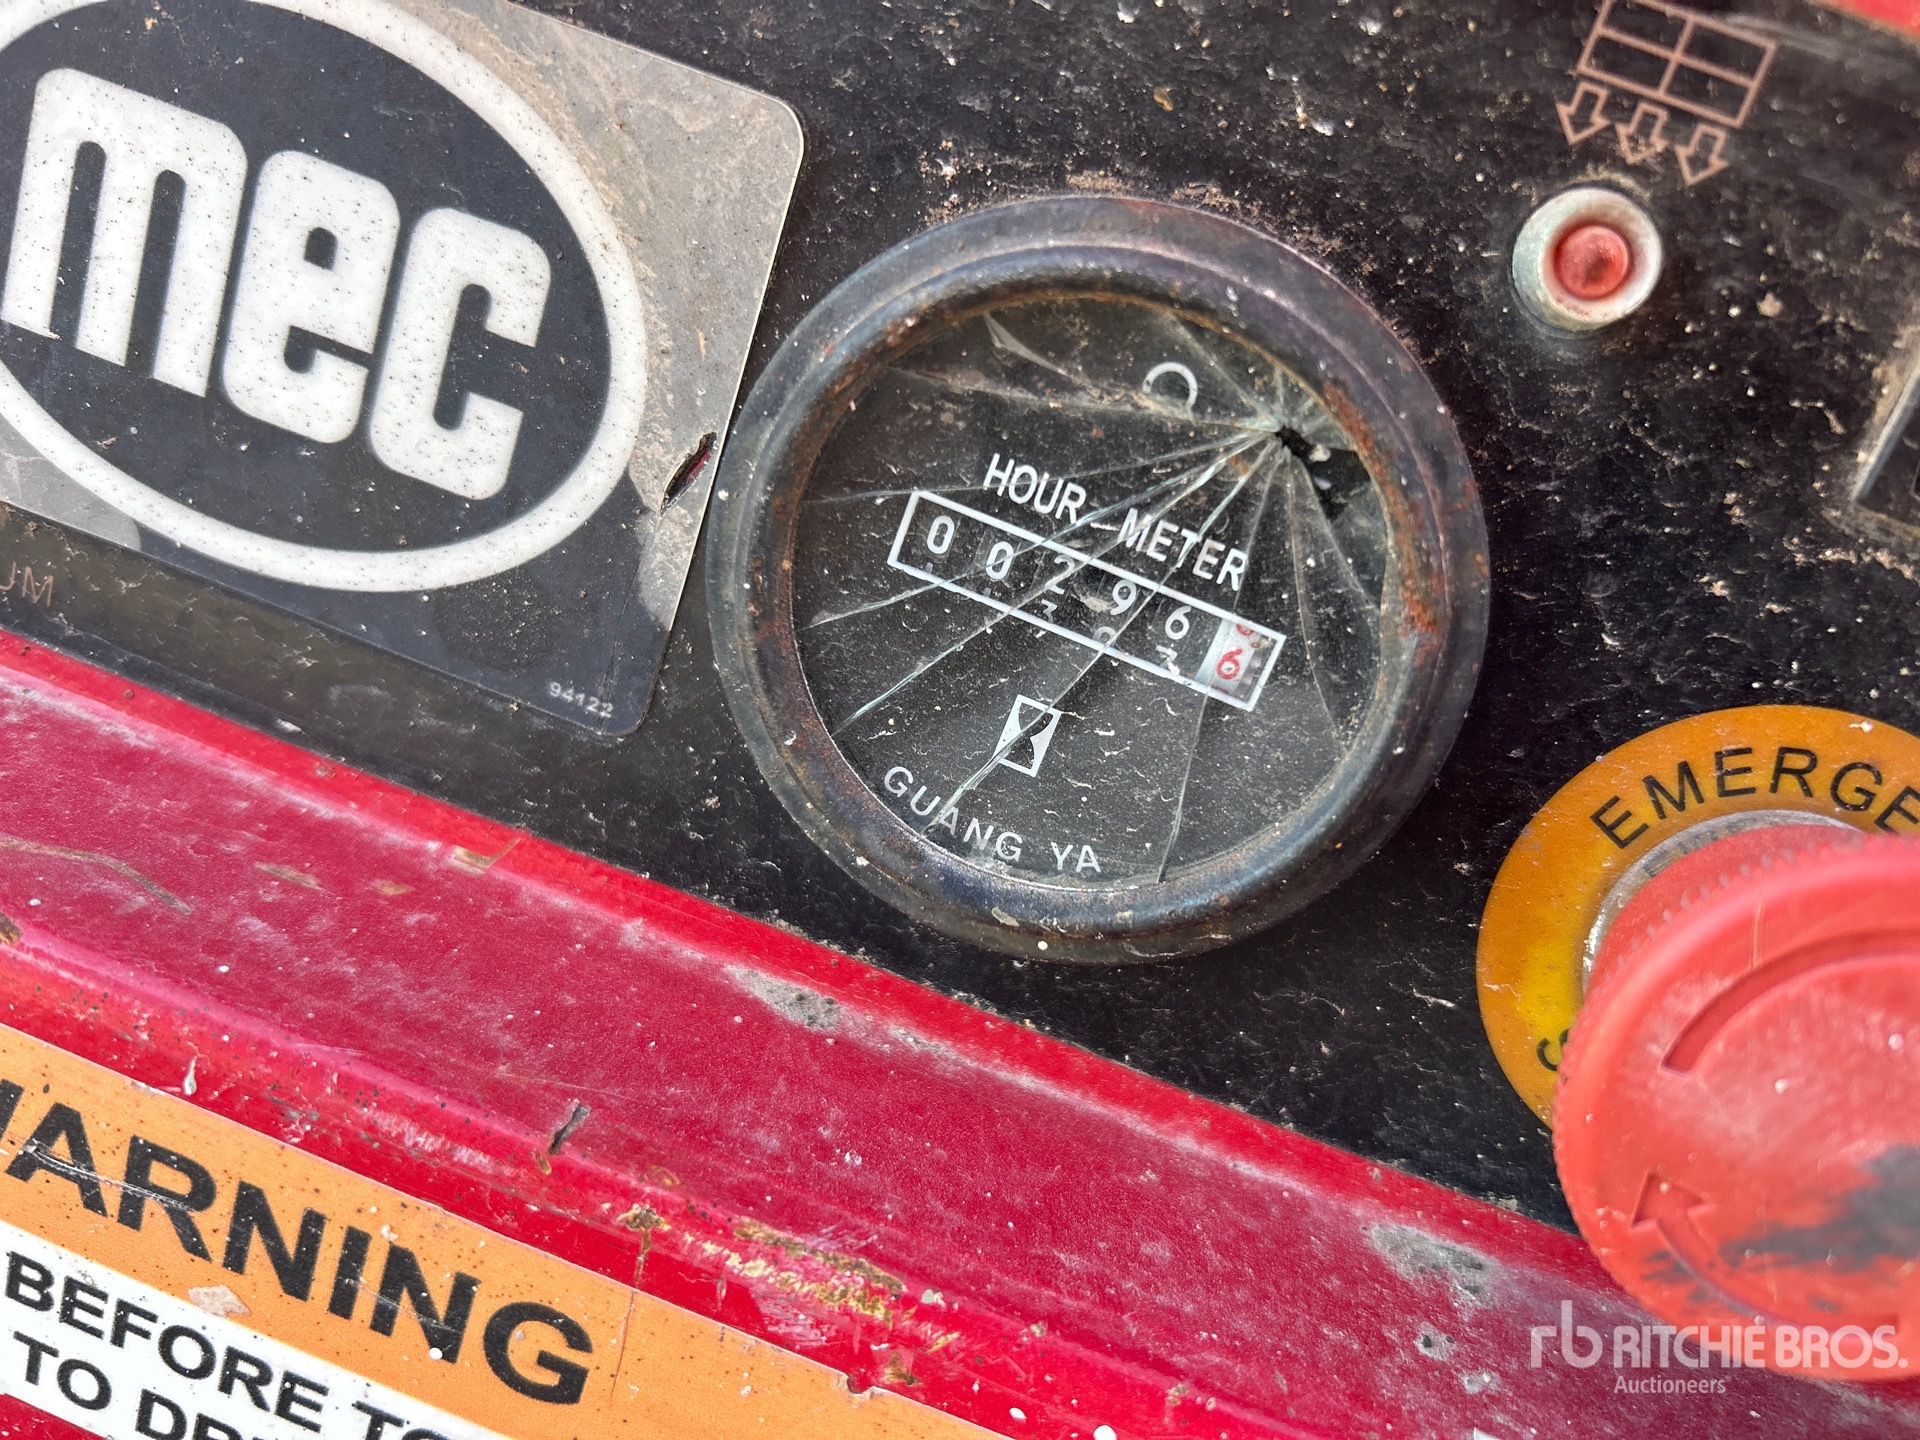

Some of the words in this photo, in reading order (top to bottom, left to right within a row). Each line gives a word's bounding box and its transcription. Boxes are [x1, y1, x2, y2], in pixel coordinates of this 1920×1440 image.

[982, 453, 1088, 523] HOUR
[1117, 507, 1248, 592] METER
[884, 766, 1023, 861] GUANG
[1051, 841, 1101, 874] YA
[5, 1250, 330, 1433] BEFORE
[352, 1400, 452, 1440] T
[12, 1330, 112, 1411] TO
